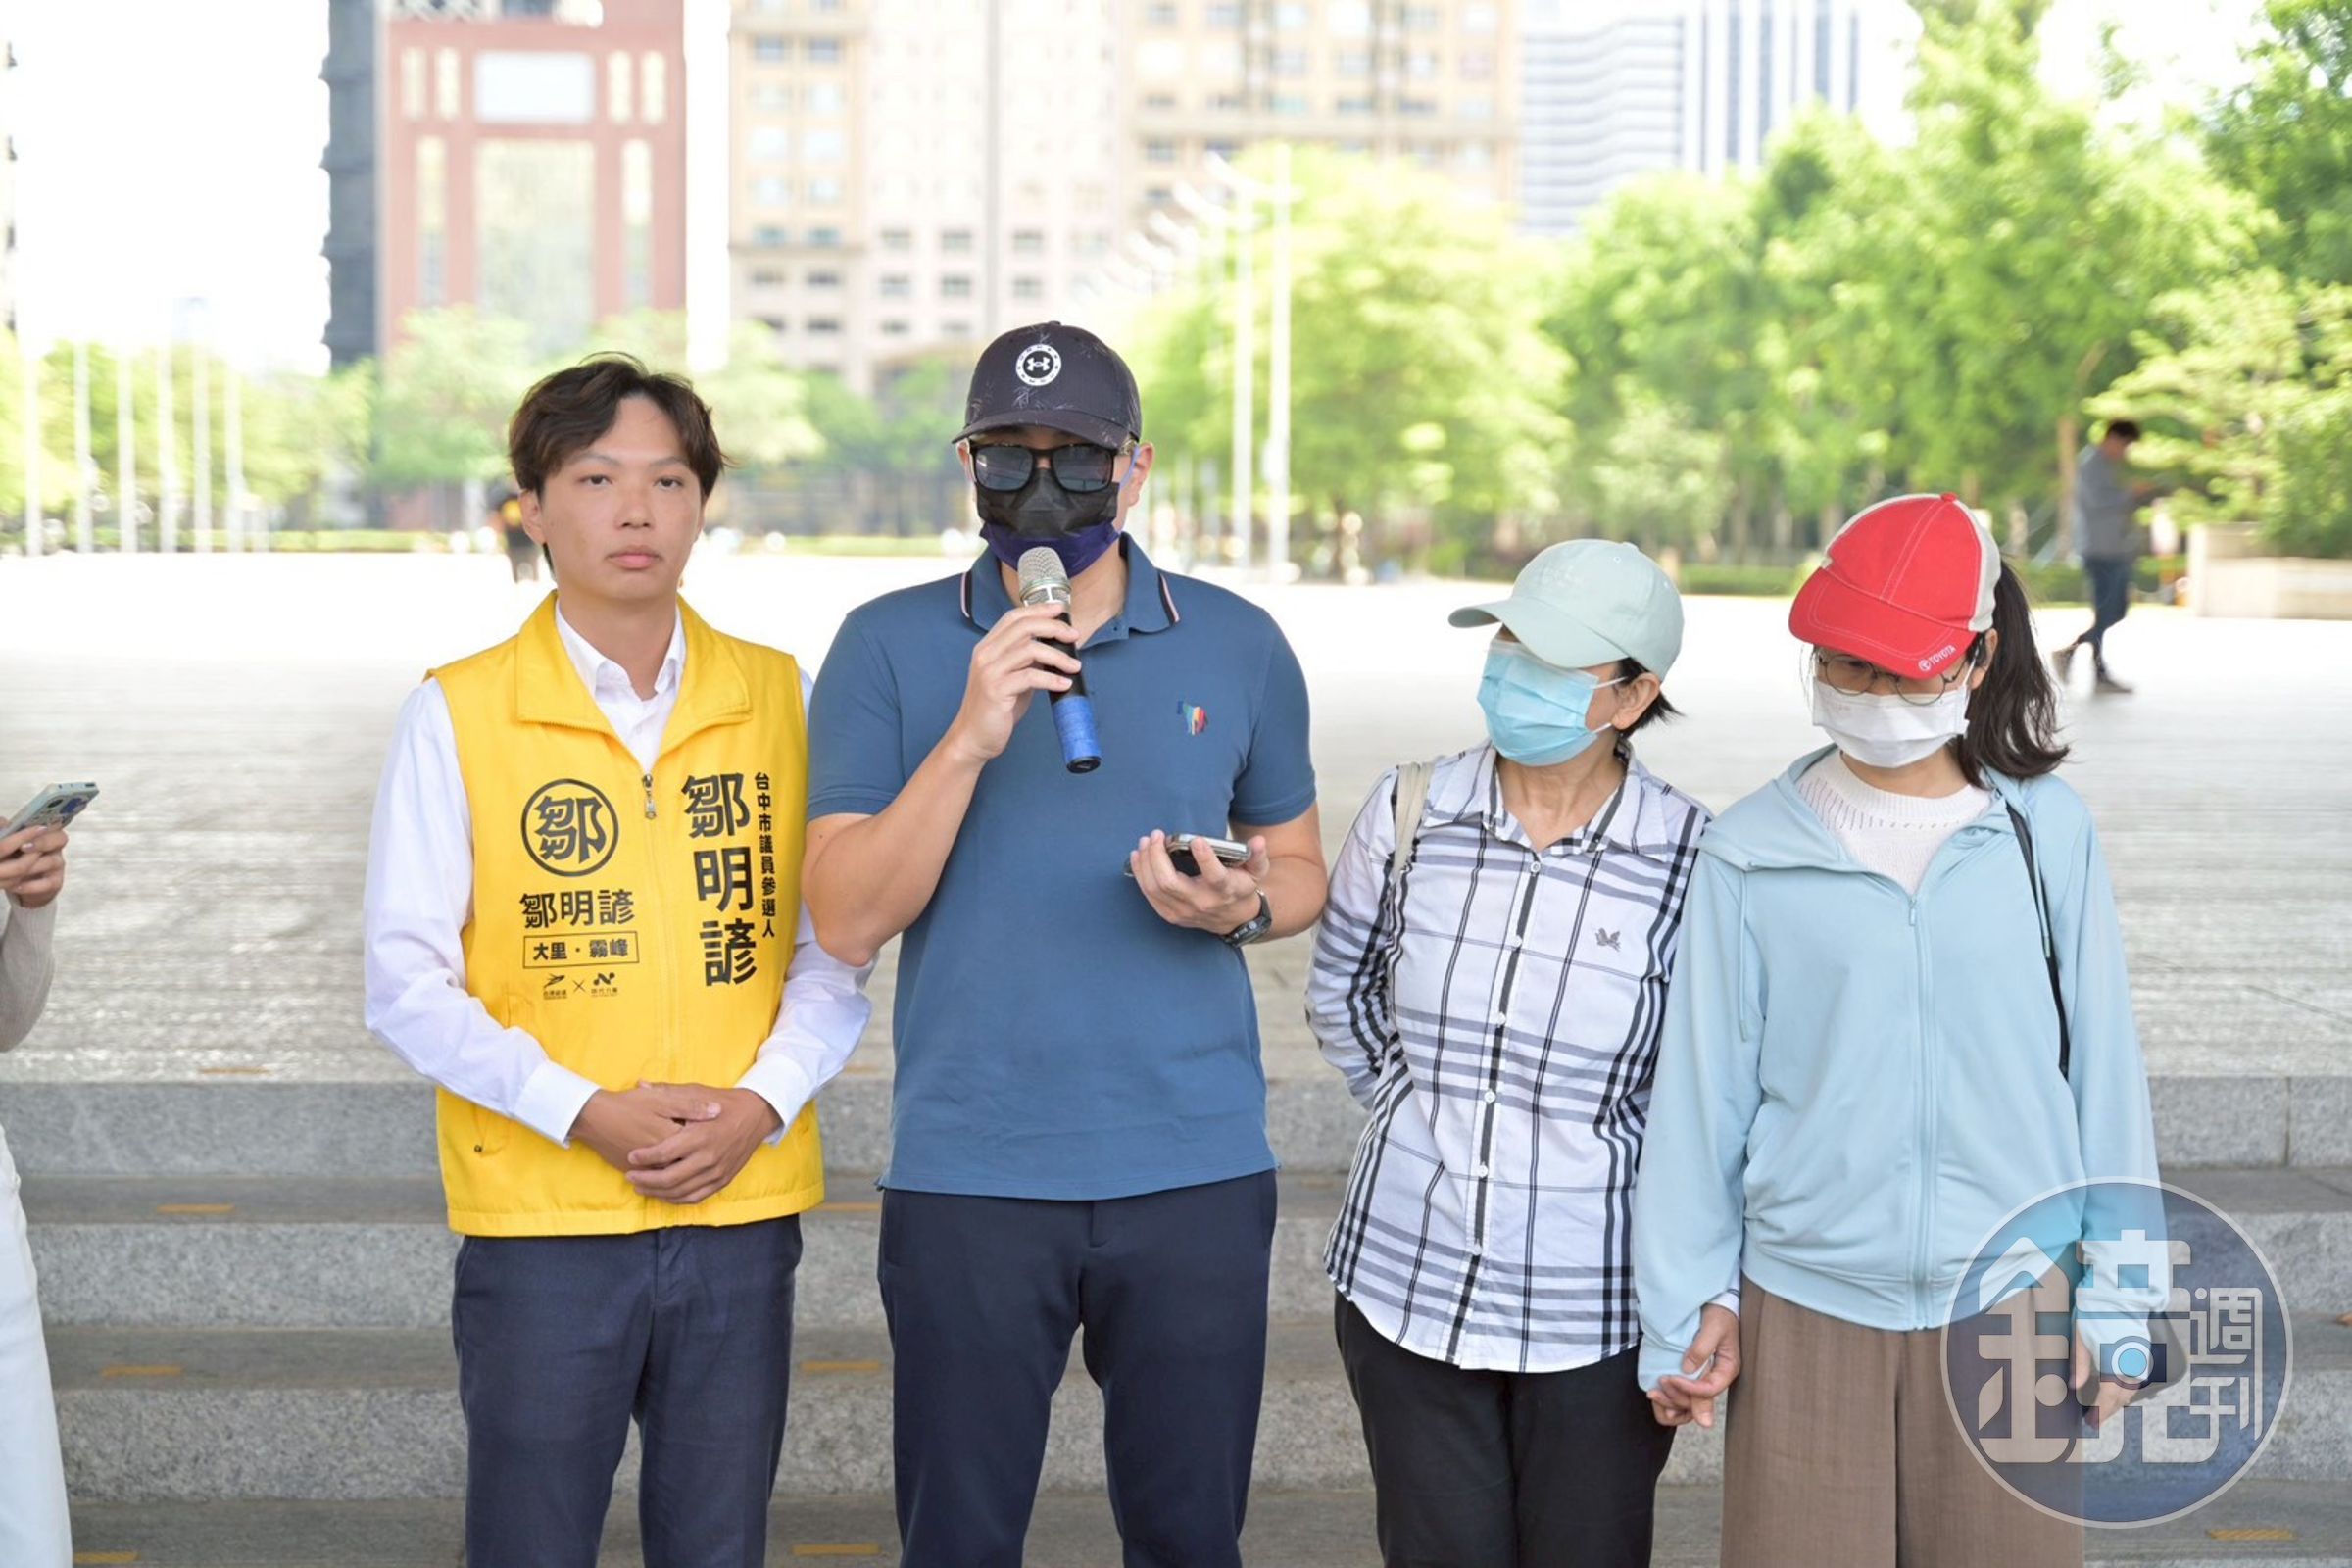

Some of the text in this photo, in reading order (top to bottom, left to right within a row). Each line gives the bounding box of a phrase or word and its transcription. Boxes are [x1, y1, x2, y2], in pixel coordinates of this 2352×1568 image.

[1928, 644, 1957, 665] TOYOTA
[534, 795, 607, 863] 鄒
[754, 771, 776, 938] 台中市議員參選人
[519, 889, 635, 929] 鄒明諺
[681, 772, 757, 987] 鄒明諺
